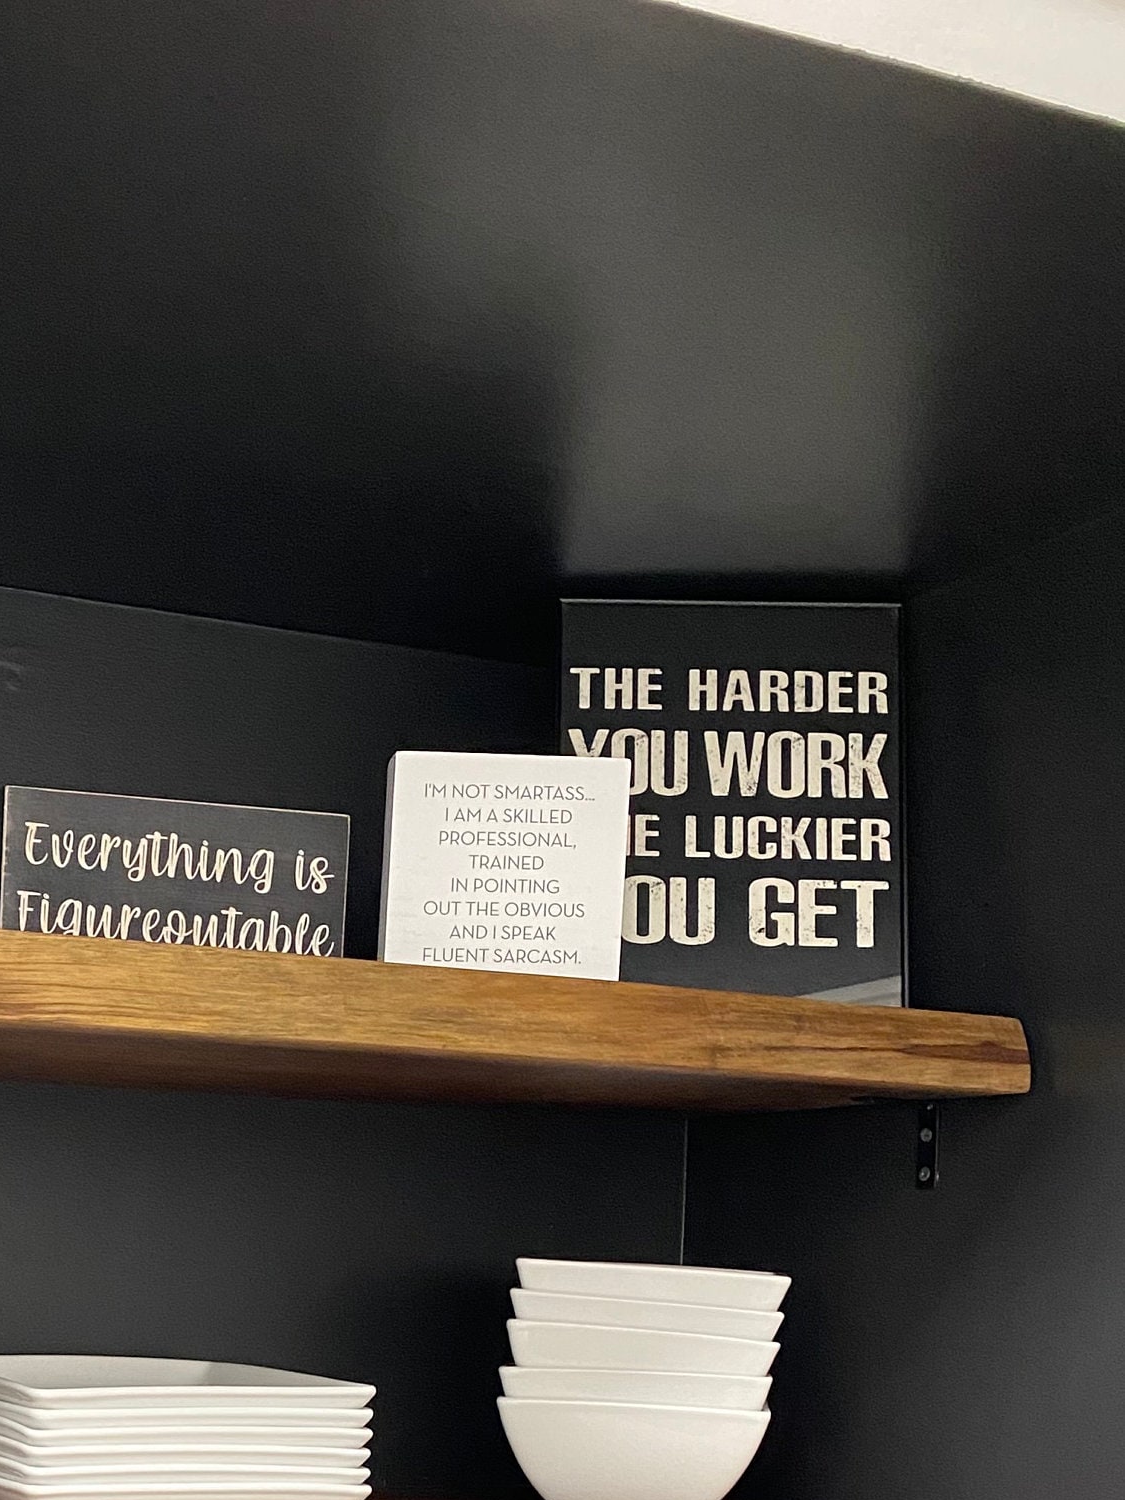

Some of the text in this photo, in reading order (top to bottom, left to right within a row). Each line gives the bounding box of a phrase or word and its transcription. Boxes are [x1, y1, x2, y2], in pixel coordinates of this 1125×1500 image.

[569, 667, 889, 714] THE HARDER
[703, 731, 889, 799] WORK
[424, 783, 596, 802] I'M NOT SMARTASS...
[444, 807, 573, 824] I AM A SKILLED
[438, 830, 577, 849] PROFESSIONAL,
[684, 815, 892, 862] LUCKIER
[25, 821, 335, 894] Everything is
[468, 854, 545, 871] TRAINED
[450, 877, 560, 895] IN POINTING
[423, 900, 585, 918] OUT THE OBVIOUS
[620, 874, 890, 948] OU GET
[449, 924, 556, 941] AND I SPEAK
[422, 947, 582, 965] FLUENT SARCASM.
